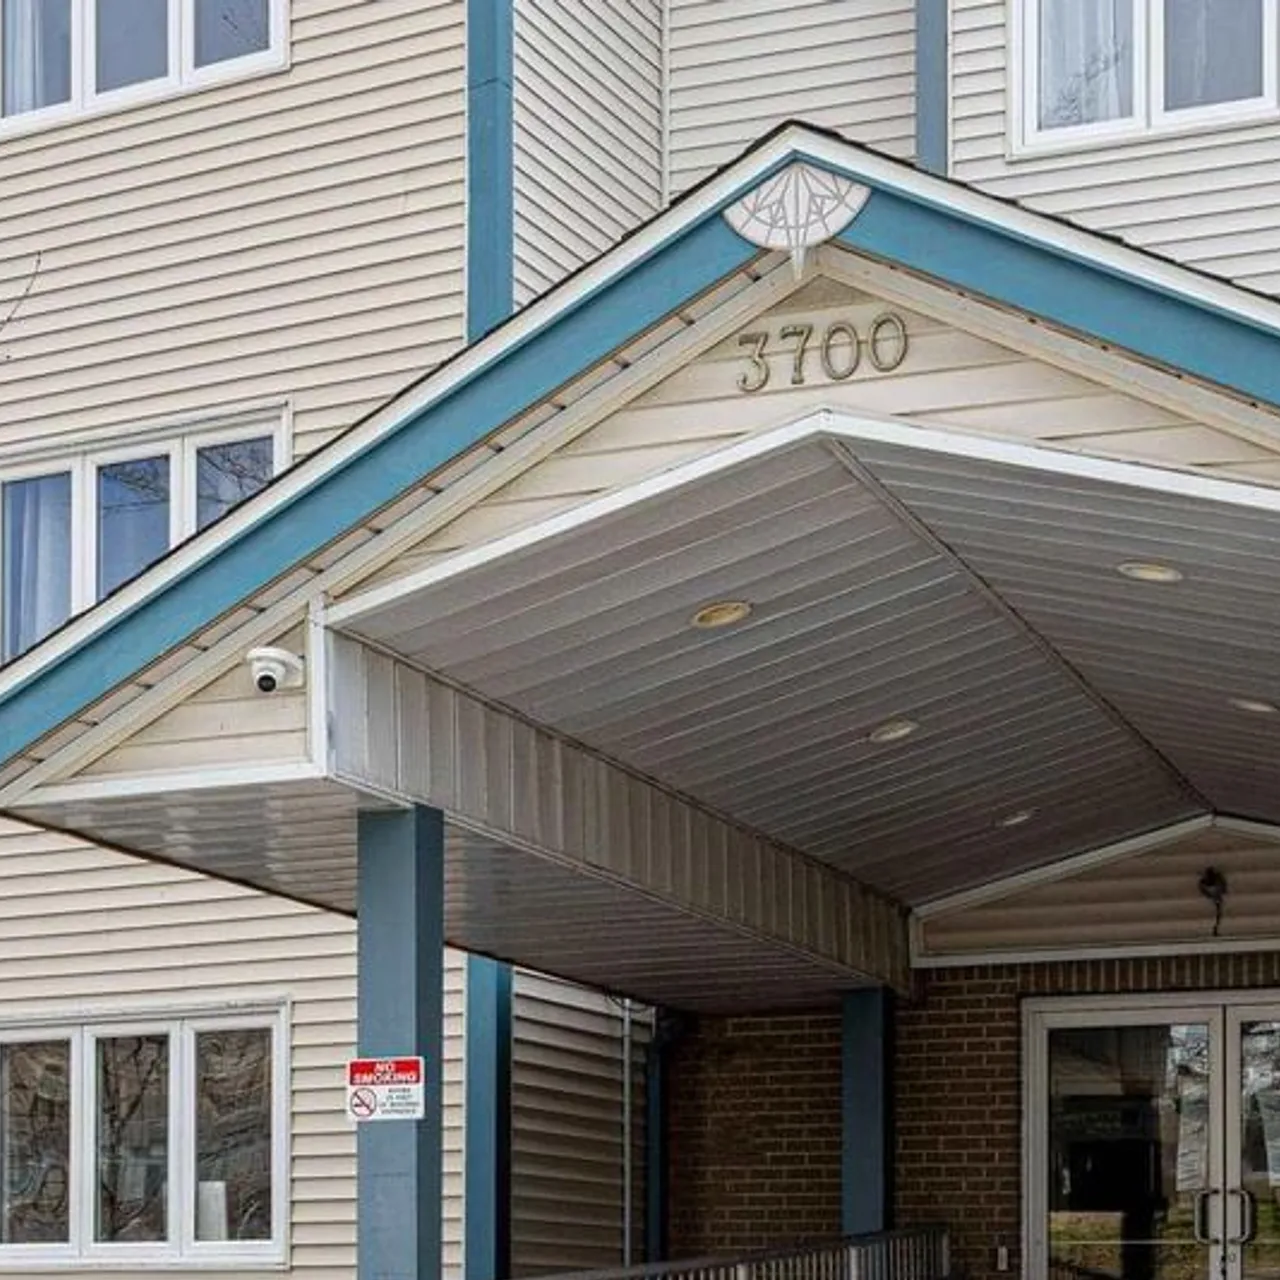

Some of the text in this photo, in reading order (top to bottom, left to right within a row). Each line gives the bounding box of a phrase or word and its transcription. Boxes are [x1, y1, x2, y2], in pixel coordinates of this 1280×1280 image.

[737, 311, 909, 392] 3700
[373, 1063, 396, 1072] NO
[353, 1072, 417, 1084] SMOKING
